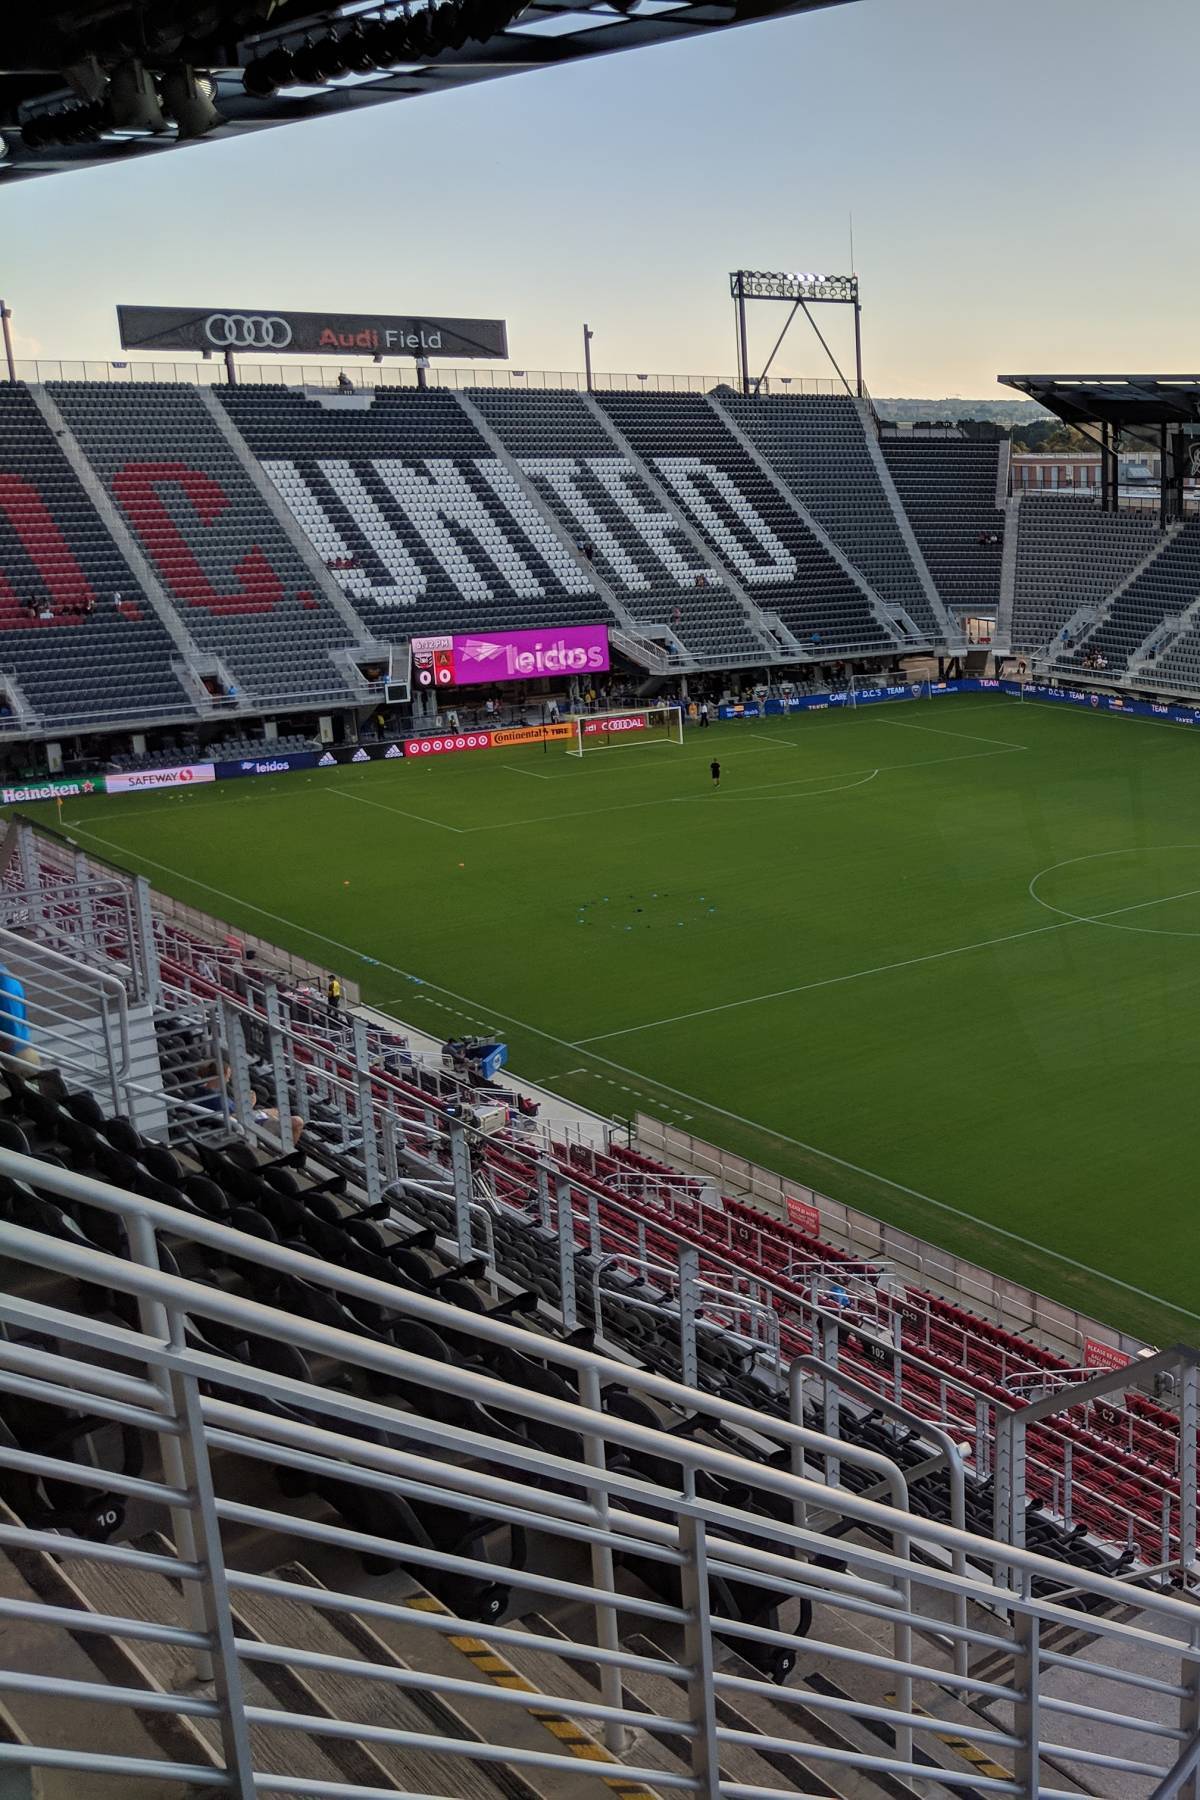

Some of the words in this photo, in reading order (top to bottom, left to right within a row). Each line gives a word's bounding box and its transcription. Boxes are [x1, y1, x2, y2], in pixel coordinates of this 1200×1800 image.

[319, 328, 378, 348] Audi
[386, 330, 442, 349] Field
[260, 457, 798, 607] UNITED
[506, 640, 604, 674] leidos
[420, 671, 431, 685] 0
[439, 669, 451, 683] 0
[779, 699, 799, 707] TAM
[1069, 692, 1085, 700] TEAM
[1152, 704, 1168, 714] TEAM
[494, 728, 542, 744] Continental
[551, 728, 568, 736] TIRE
[256, 760, 289, 773] leidos
[128, 773, 177, 787] SAFEWAY
[1, 782, 80, 803] Heineken
[871, 1346, 885, 1360] 102
[1103, 1408, 1114, 1423] C2
[97, 1509, 117, 1527] 10
[491, 1600, 499, 1612] 9
